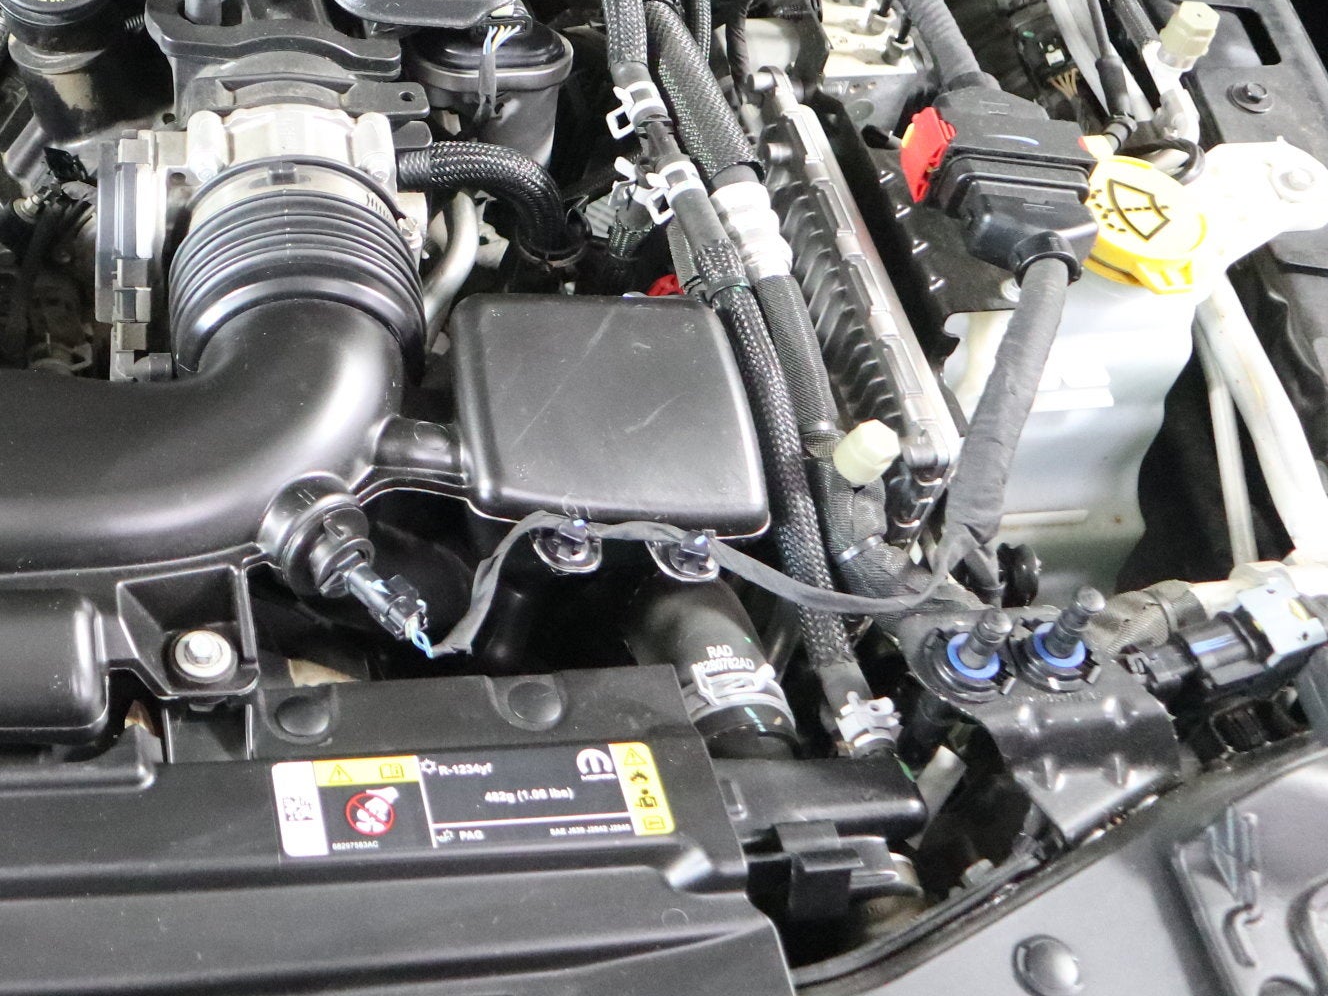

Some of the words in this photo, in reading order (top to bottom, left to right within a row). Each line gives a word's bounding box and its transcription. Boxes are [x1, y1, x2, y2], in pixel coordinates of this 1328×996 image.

[706, 645, 733, 658] RAD
[438, 762, 494, 777] R-1234yf
[459, 830, 485, 841] PAG
